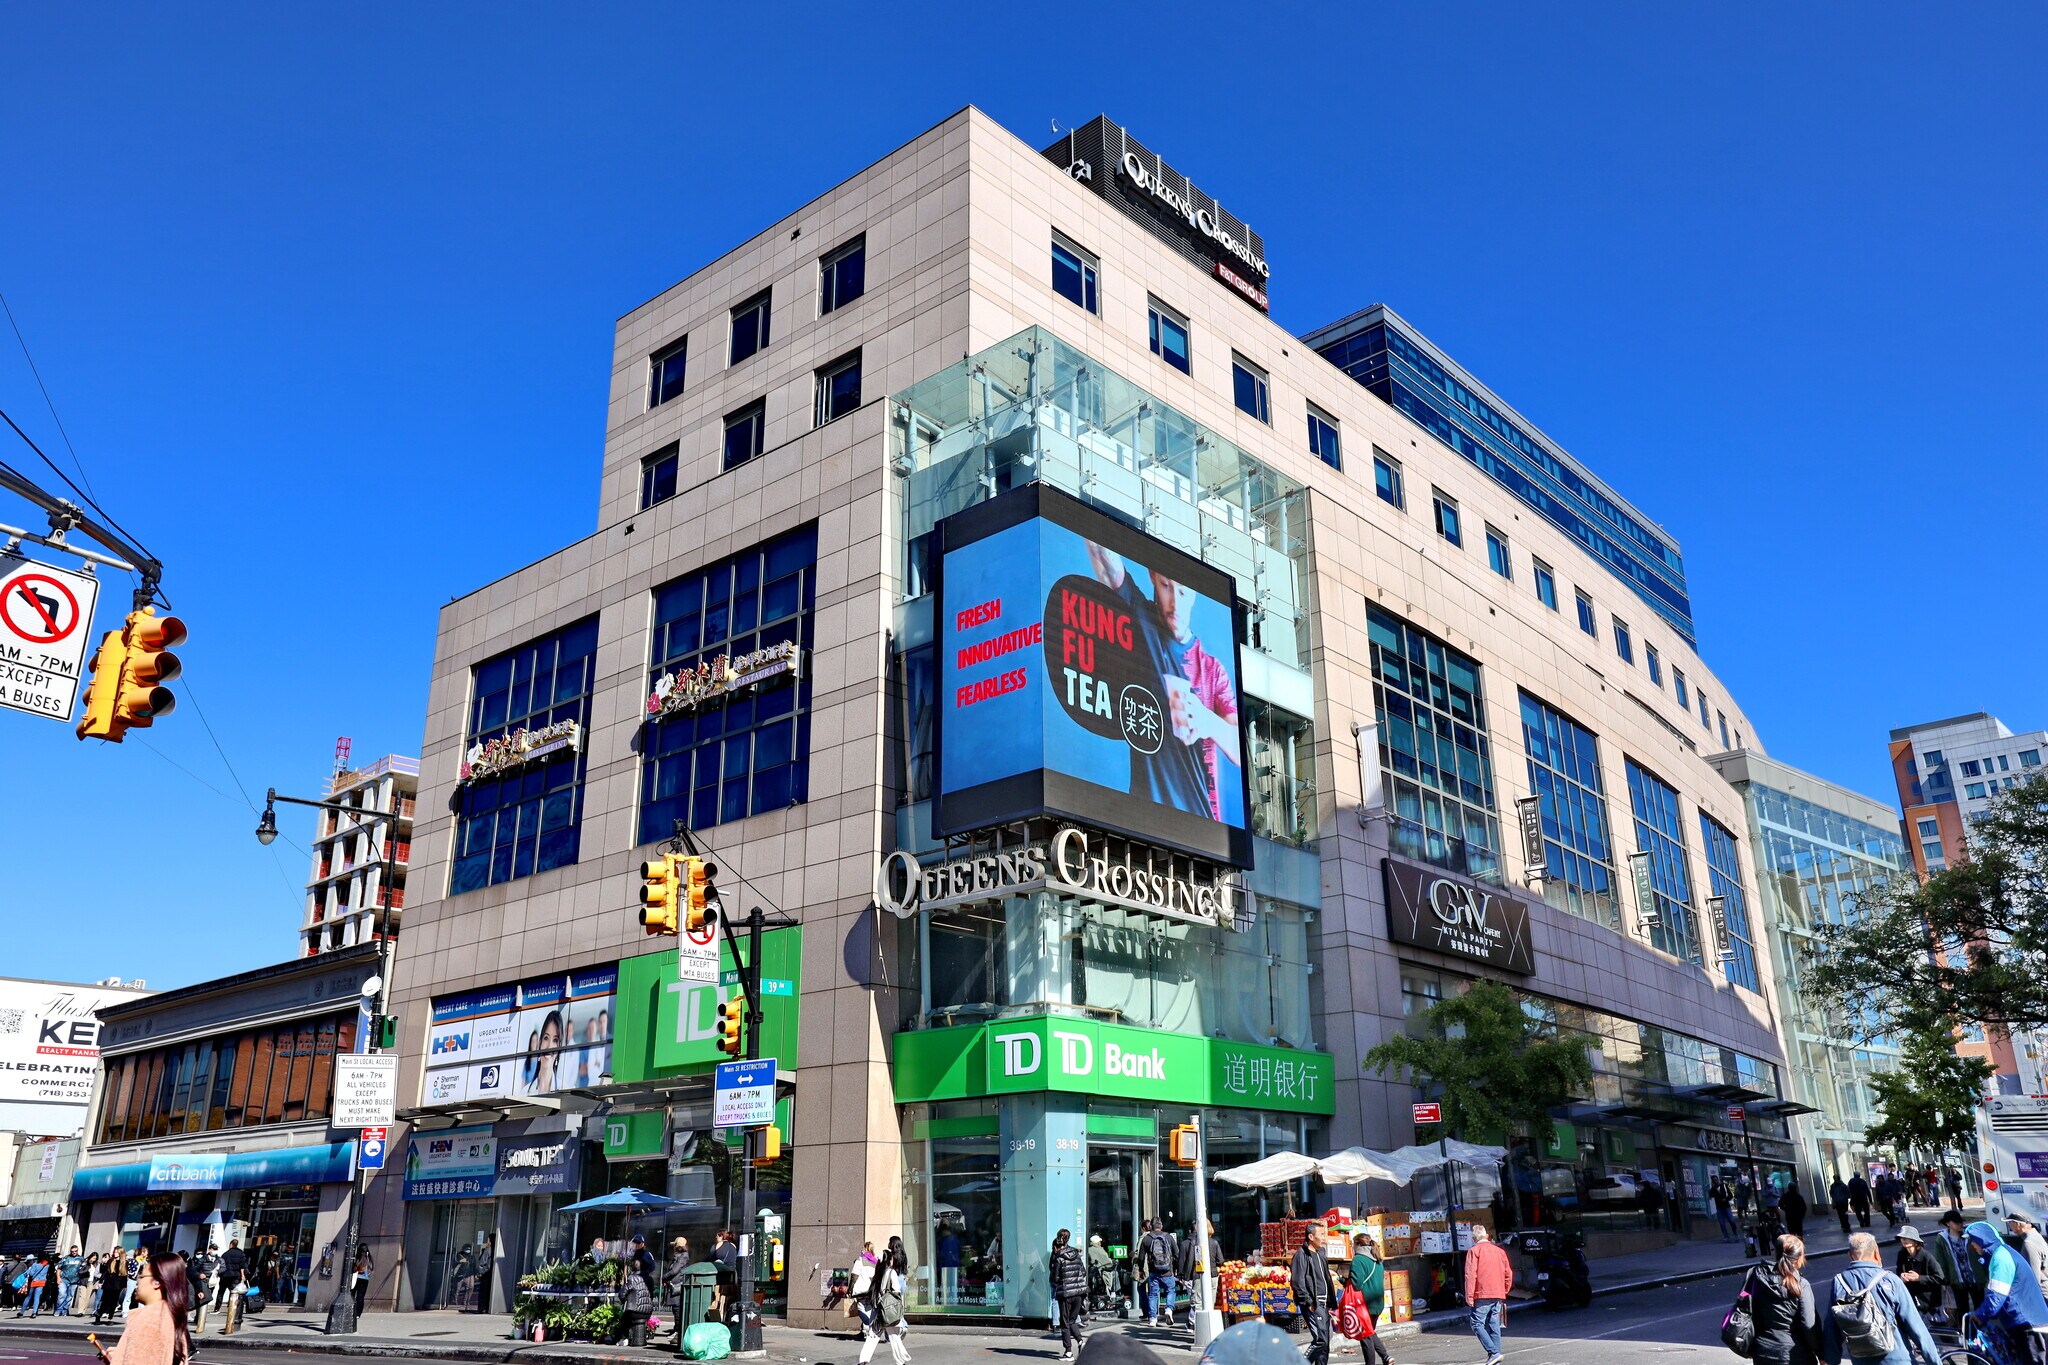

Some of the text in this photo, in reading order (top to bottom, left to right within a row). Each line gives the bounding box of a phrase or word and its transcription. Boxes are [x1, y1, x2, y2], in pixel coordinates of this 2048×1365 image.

[1123, 152, 1270, 278] QUEENS CROSSING
[1220, 265, 1268, 306] F&T GROUP
[956, 598, 1001, 632] FRESH
[1062, 589, 1133, 651] KUNG
[957, 621, 1043, 669] INNOVATIVE
[1062, 628, 1095, 673] FU
[40, 654, 73, 674] 7PM
[737, 662, 787, 687] RESTAURANT
[956, 667, 1027, 708] FEARLESS
[1063, 667, 1113, 720] TEA
[13, 689, 61, 712] BUSES
[876, 828, 1217, 919] QUEENS CROSSING
[1443, 926, 1458, 937] KTV
[1470, 934, 1493, 947] PARTY
[689, 960, 710, 969] EXCEPT
[704, 951, 717, 959] 7PM
[697, 971, 715, 980] BUSES
[726, 973, 739, 984] Main
[527, 985, 560, 999] RADIOLOGY
[768, 982, 777, 993] 39
[455, 1002, 468, 1011] CARE
[667, 981, 728, 1043] TD
[479, 1026, 512, 1037] URGENT CARE
[40, 1047, 69, 1055] REALTY
[995, 1032, 1041, 1076] TD
[1054, 1031, 1167, 1081] TD Bank
[741, 1063, 769, 1071] RESTRICTION
[441, 1075, 460, 1083] Sherman
[1224, 1053, 1319, 1102] 道明银行
[439, 1091, 449, 1099] Labs
[729, 1092, 742, 1100] 6AM
[748, 1091, 761, 1099] 7PM
[717, 1114, 733, 1122] EXCEPT
[608, 1124, 627, 1147] TD
[1010, 1139, 1036, 1151] 38-19
[1056, 1139, 1079, 1150] 38-19
[506, 1147, 540, 1168] SONG
[540, 1144, 565, 1167] TEA
[156, 1165, 217, 1182] citibank
